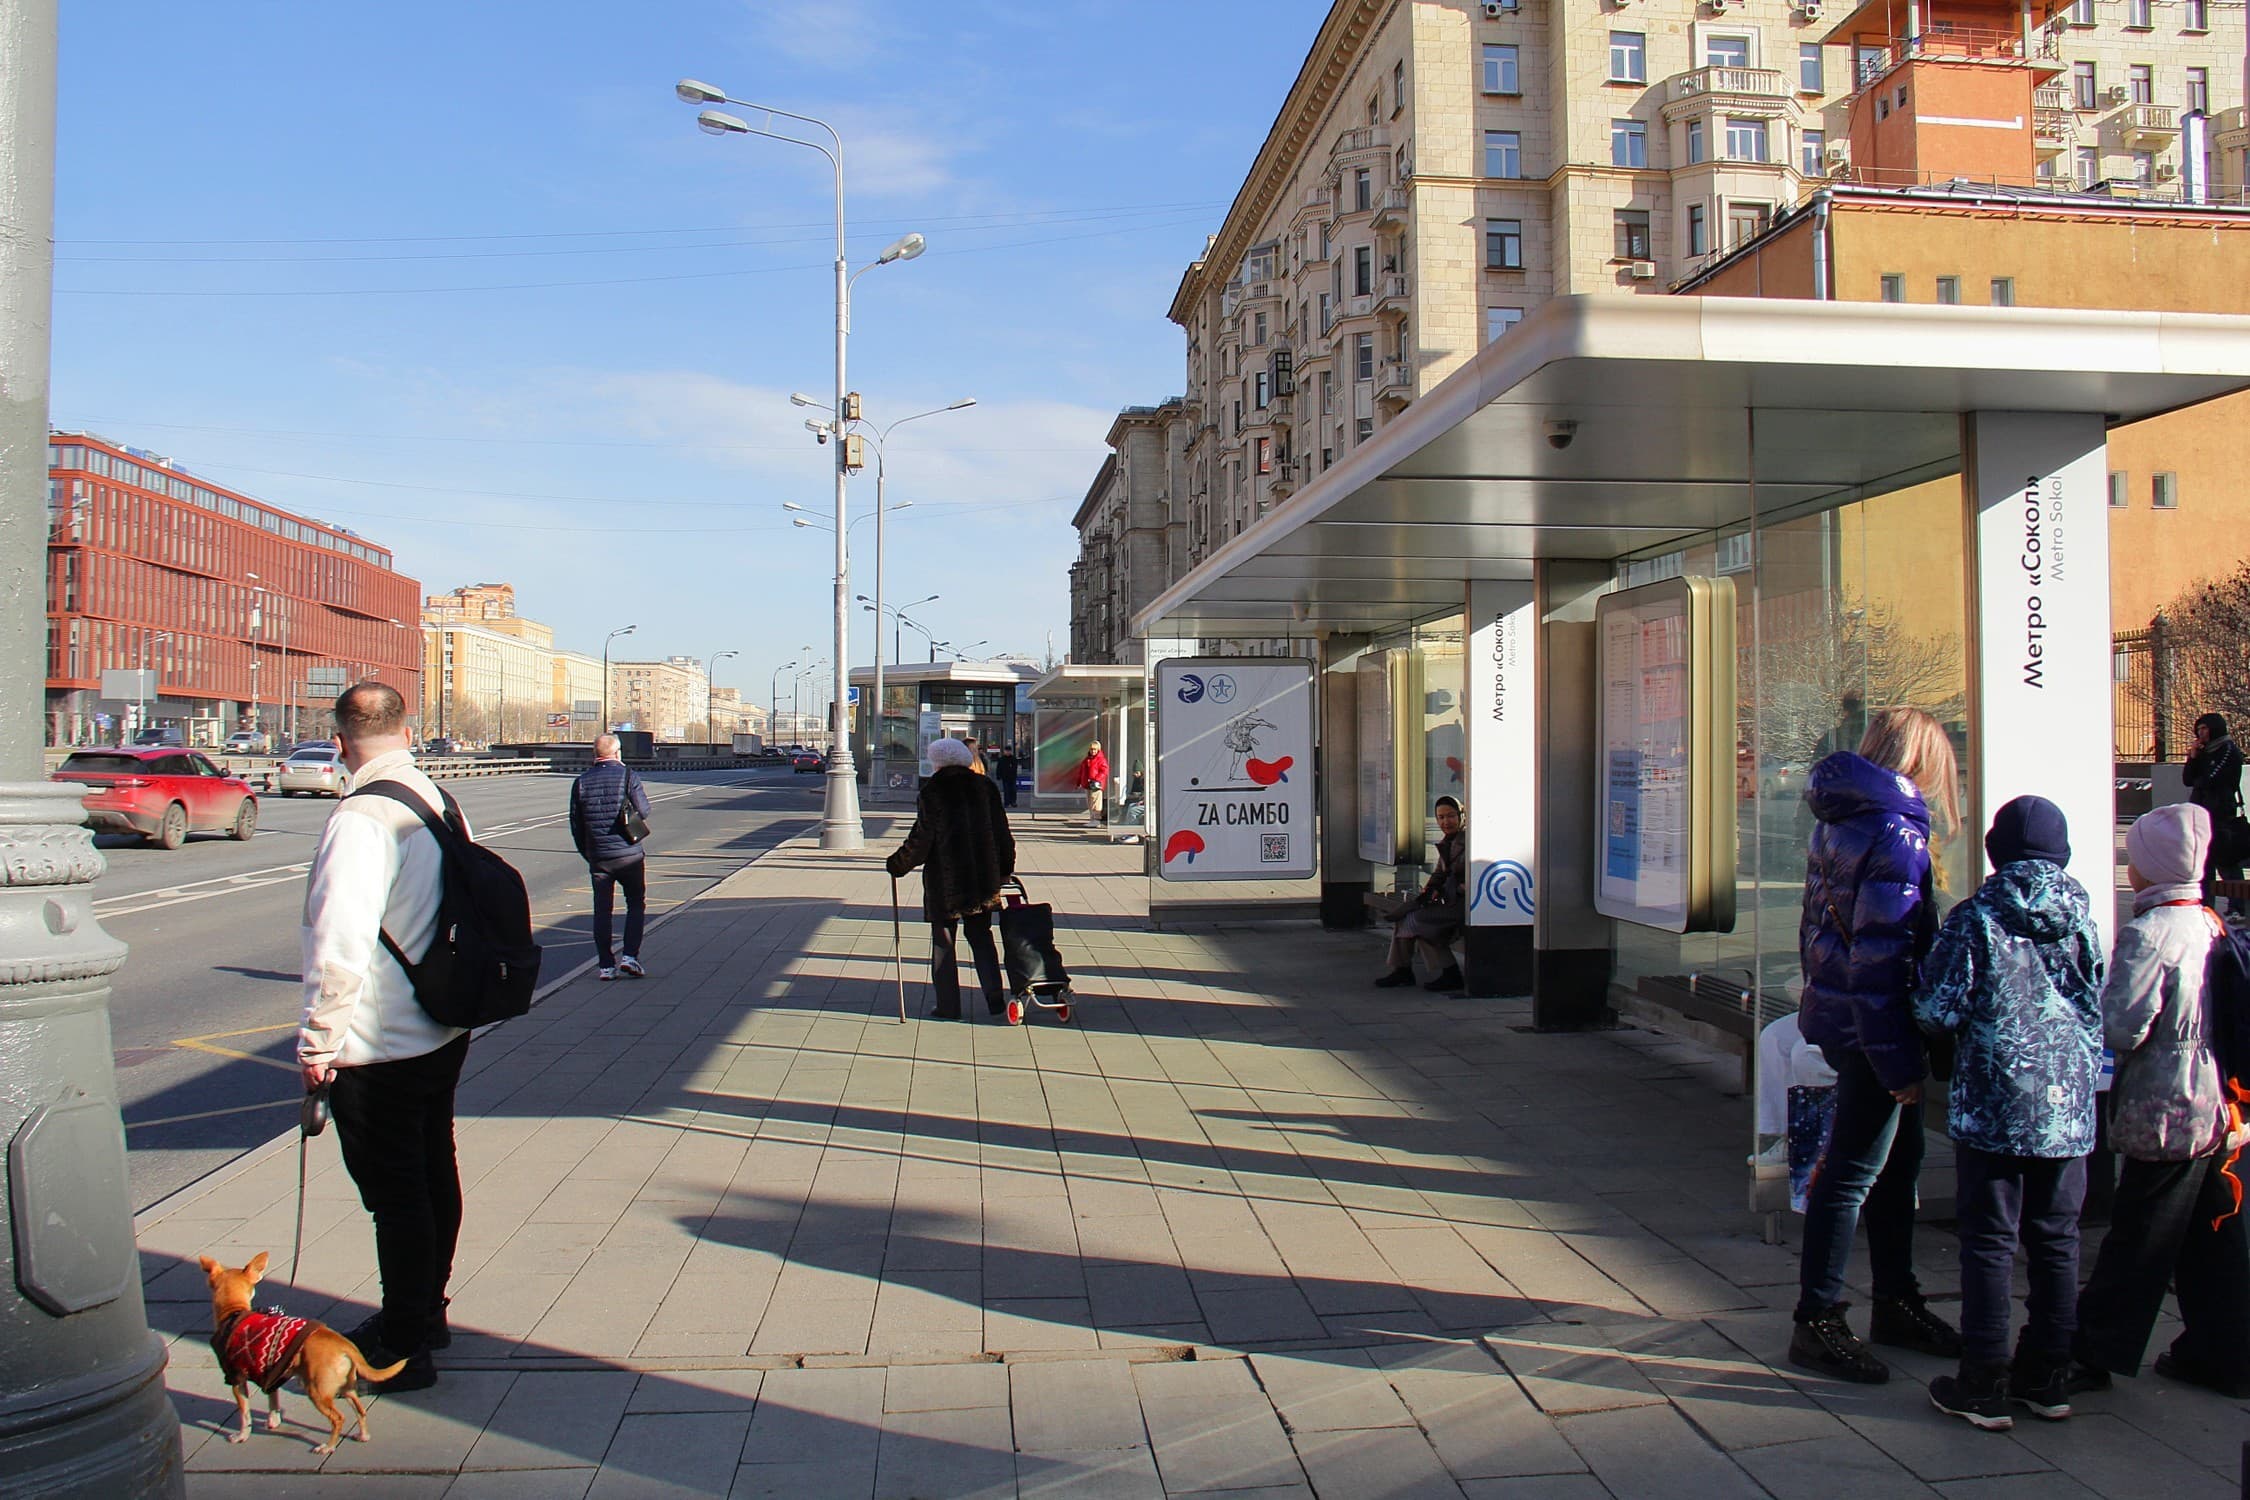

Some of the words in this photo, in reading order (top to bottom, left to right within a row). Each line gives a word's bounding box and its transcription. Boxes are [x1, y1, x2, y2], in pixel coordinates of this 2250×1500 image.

[2048, 475, 2064, 523] Sokol
[2021, 475, 2042, 586] «Сокол»
[2050, 527, 2065, 582] Metro
[1492, 612, 1504, 670] «Сокол»
[2023, 595, 2046, 689] Метро
[1492, 673, 1506, 722] Метро
[1198, 803, 1220, 826] ZA
[1226, 802, 1289, 825] САМБО
